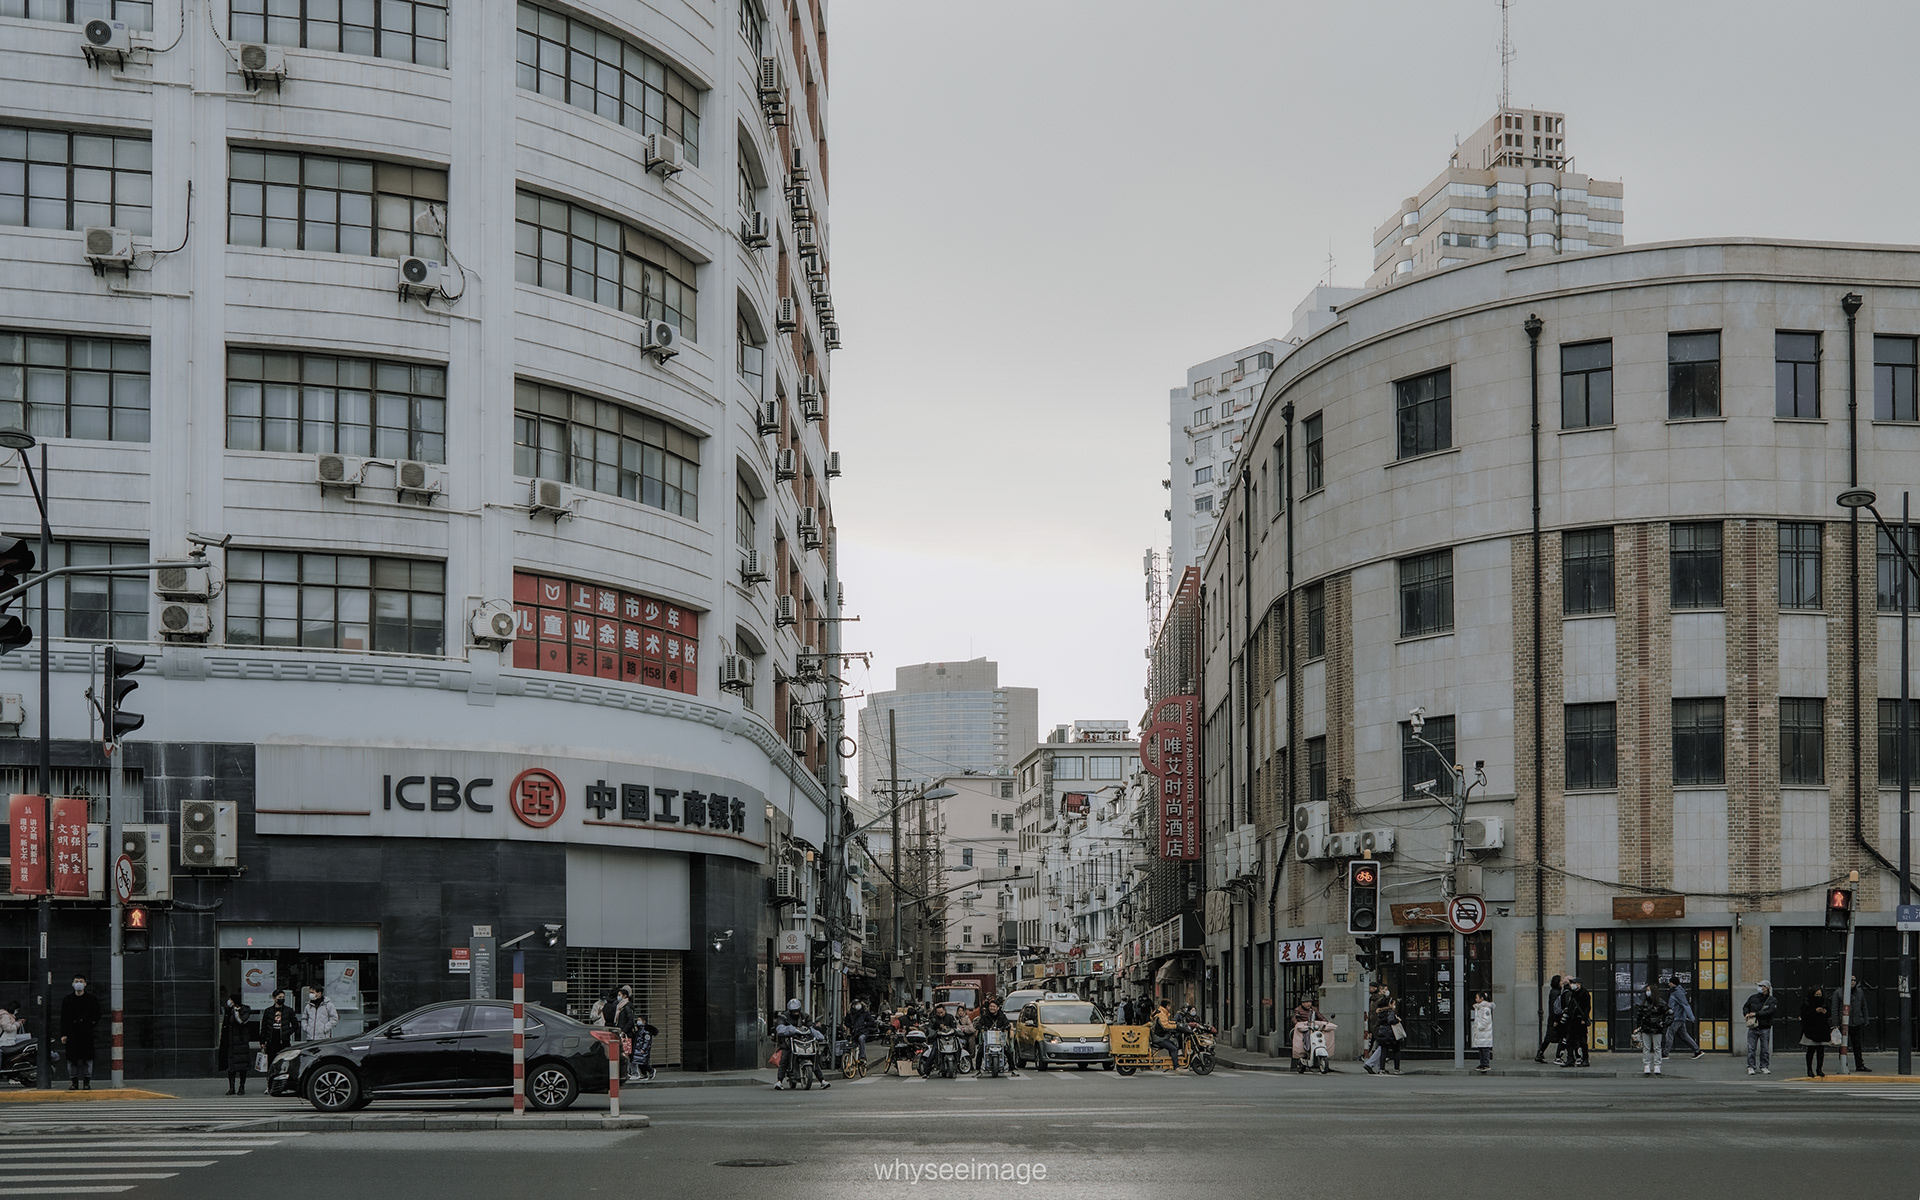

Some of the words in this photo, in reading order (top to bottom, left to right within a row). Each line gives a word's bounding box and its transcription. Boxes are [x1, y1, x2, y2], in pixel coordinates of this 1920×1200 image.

[574, 587, 680, 629] 上海市少年
[516, 609, 696, 665] 儿童业余美术学校
[576, 652, 678, 684] 天津路158号
[1186, 699, 1194, 720] ONLY
[1186, 721, 1194, 742] LOVE
[1186, 743, 1194, 777] FASHION
[383, 774, 494, 813] ICBC
[585, 779, 746, 834] 中国工商银行
[1164, 736, 1183, 858] 唯艾时尚酒店
[1186, 778, 1194, 804] HOTEL
[1186, 805, 1194, 820] TEL
